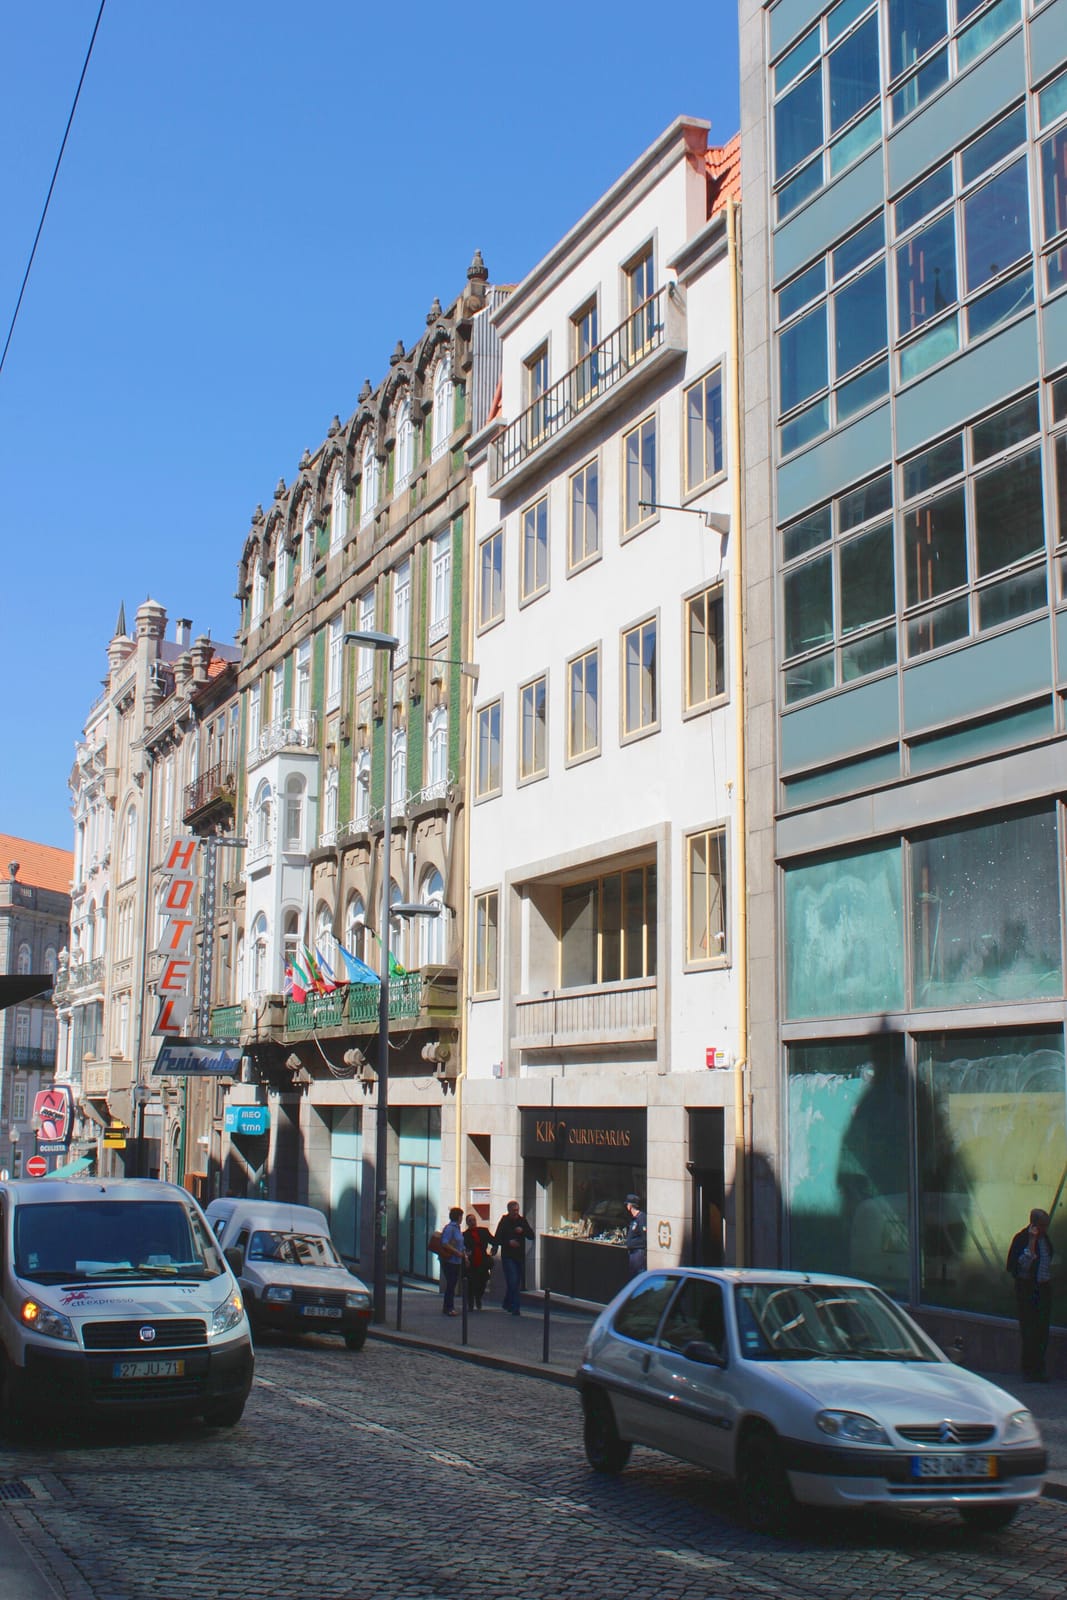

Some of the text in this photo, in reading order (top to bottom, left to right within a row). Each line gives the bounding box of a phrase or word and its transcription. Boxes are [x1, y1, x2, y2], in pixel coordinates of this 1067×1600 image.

[159, 840, 197, 1031] HOTEL
[157, 1048, 240, 1071] Peninsular
[241, 1110, 262, 1119] MEO
[241, 1123, 261, 1131] tmn
[569, 1128, 631, 1146] OURIVESARIAS
